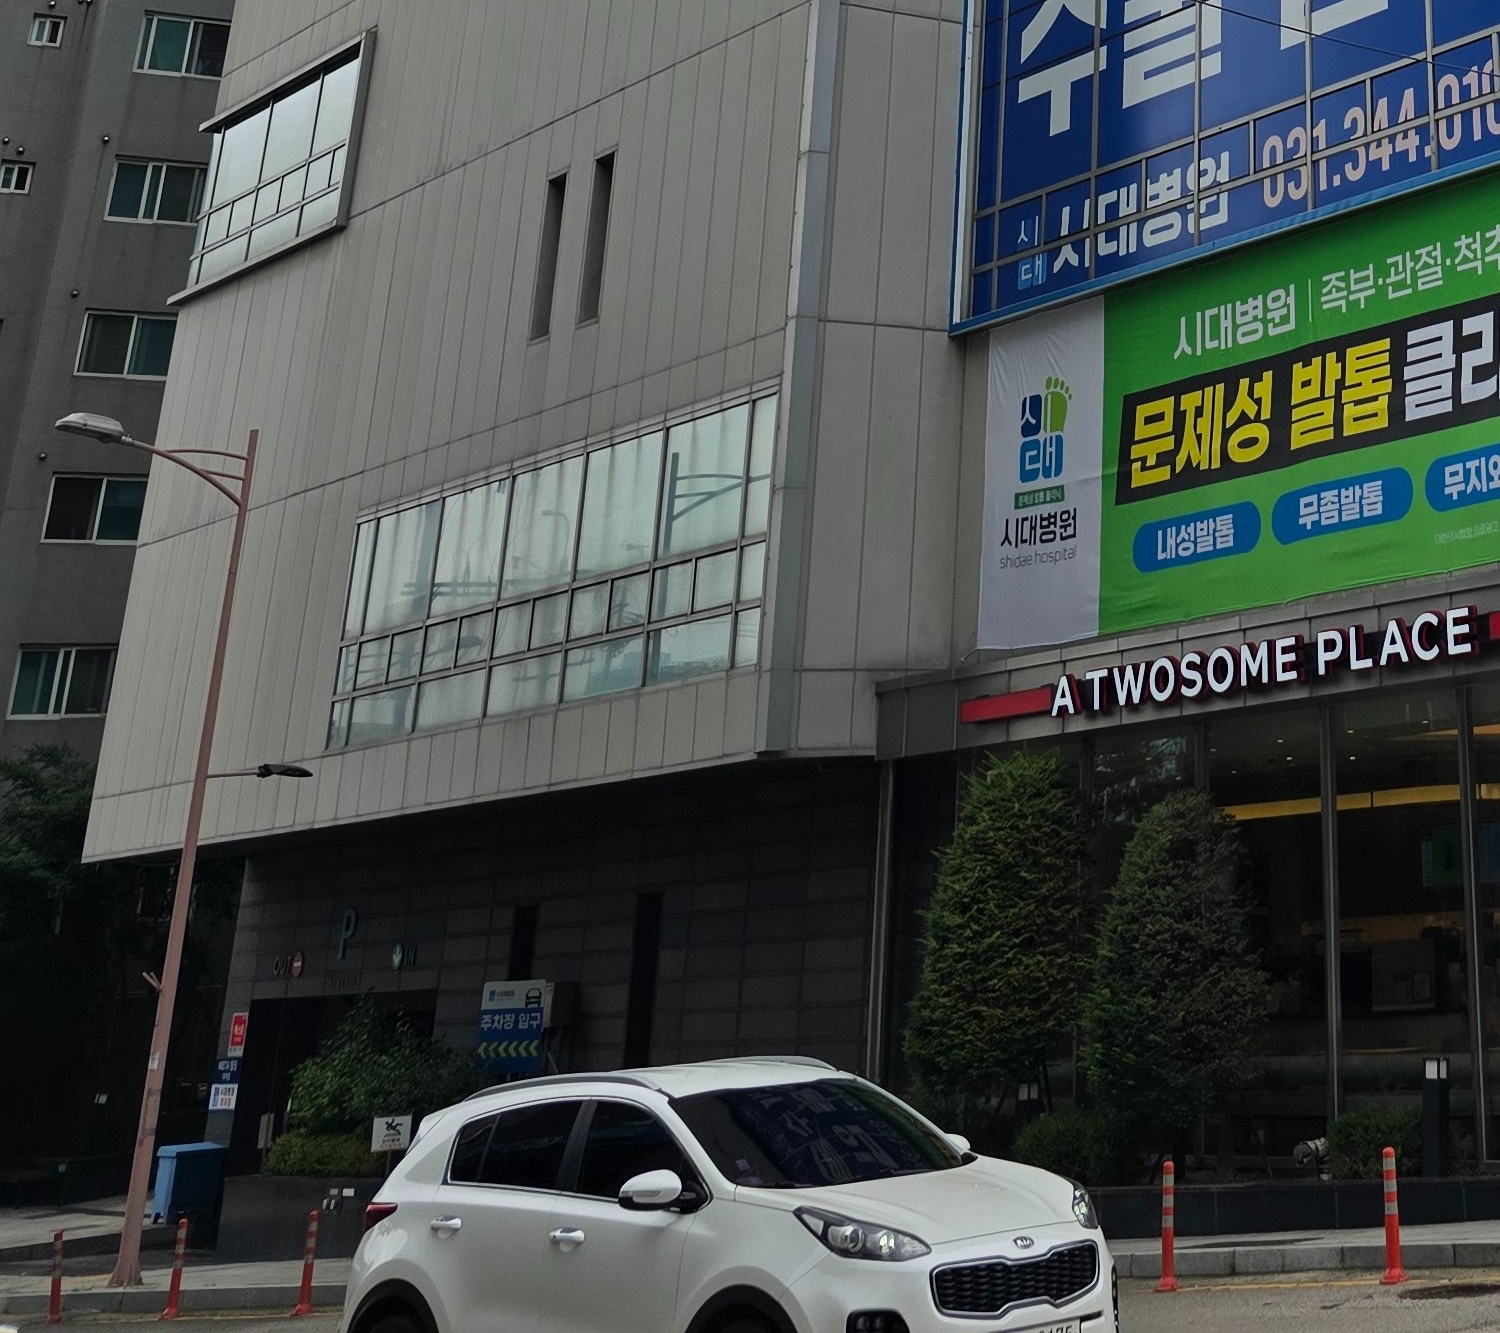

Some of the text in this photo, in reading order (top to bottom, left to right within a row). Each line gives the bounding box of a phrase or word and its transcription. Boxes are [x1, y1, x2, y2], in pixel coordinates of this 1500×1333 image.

[1053, 149, 1231, 275] 시대병원
[1174, 284, 1297, 361] 시대병원
[1129, 371, 1272, 490] 문제성
[1290, 336, 1392, 447] 발톱
[1000, 507, 1078, 549] 시대병원
[1298, 481, 1385, 531] 무좀발톱
[1000, 544, 1077, 569] shidae hospital
[1156, 515, 1235, 561] 내성발톱
[1051, 607, 1473, 716] A TWOSOME PLACE
[480, 1012, 541, 1031] 주차장 입구
